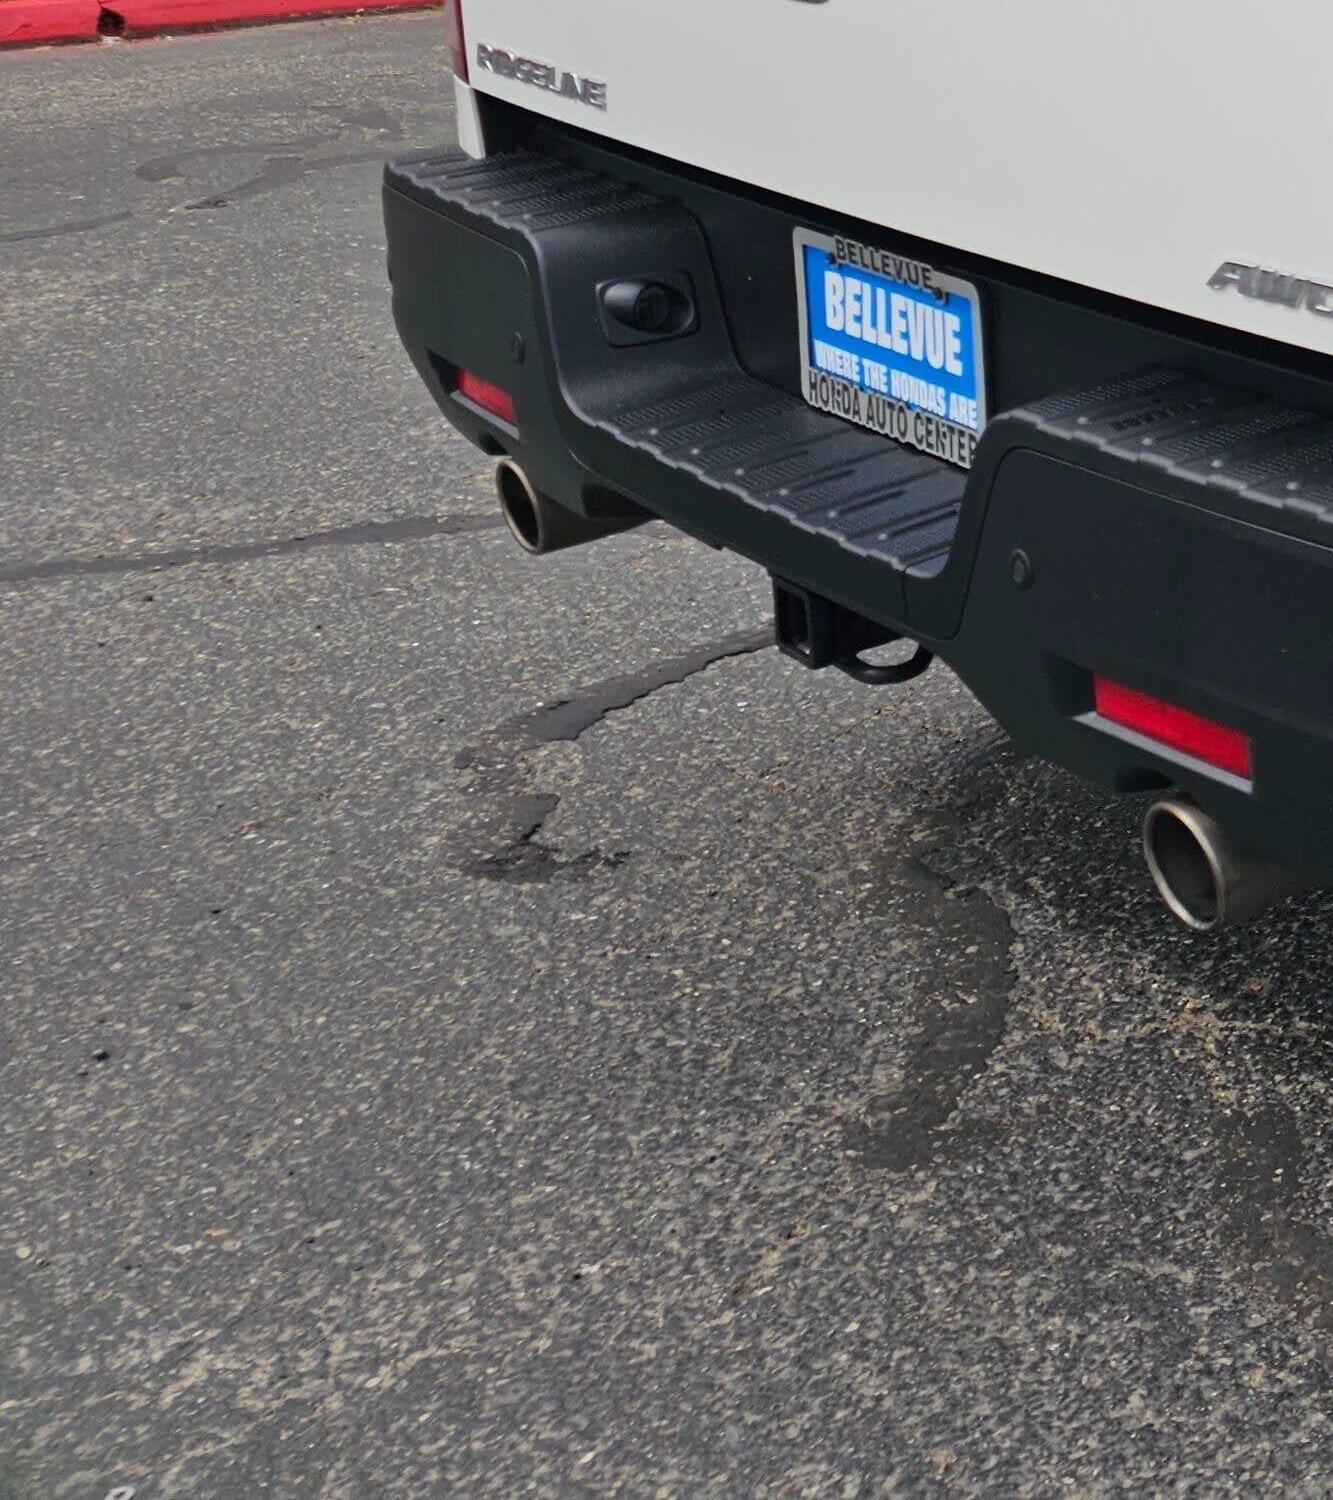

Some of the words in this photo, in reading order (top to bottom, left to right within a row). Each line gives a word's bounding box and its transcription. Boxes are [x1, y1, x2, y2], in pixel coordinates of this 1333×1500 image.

[834, 237, 934, 289] BELLEVUE
[823, 270, 964, 377] BELLEVUE
[808, 369, 862, 422] HONDA
[865, 393, 909, 438] AUTO
[813, 340, 861, 384] WHERE
[862, 358, 888, 392] THE
[891, 367, 946, 417] HONDAS
[948, 392, 978, 430] ARE
